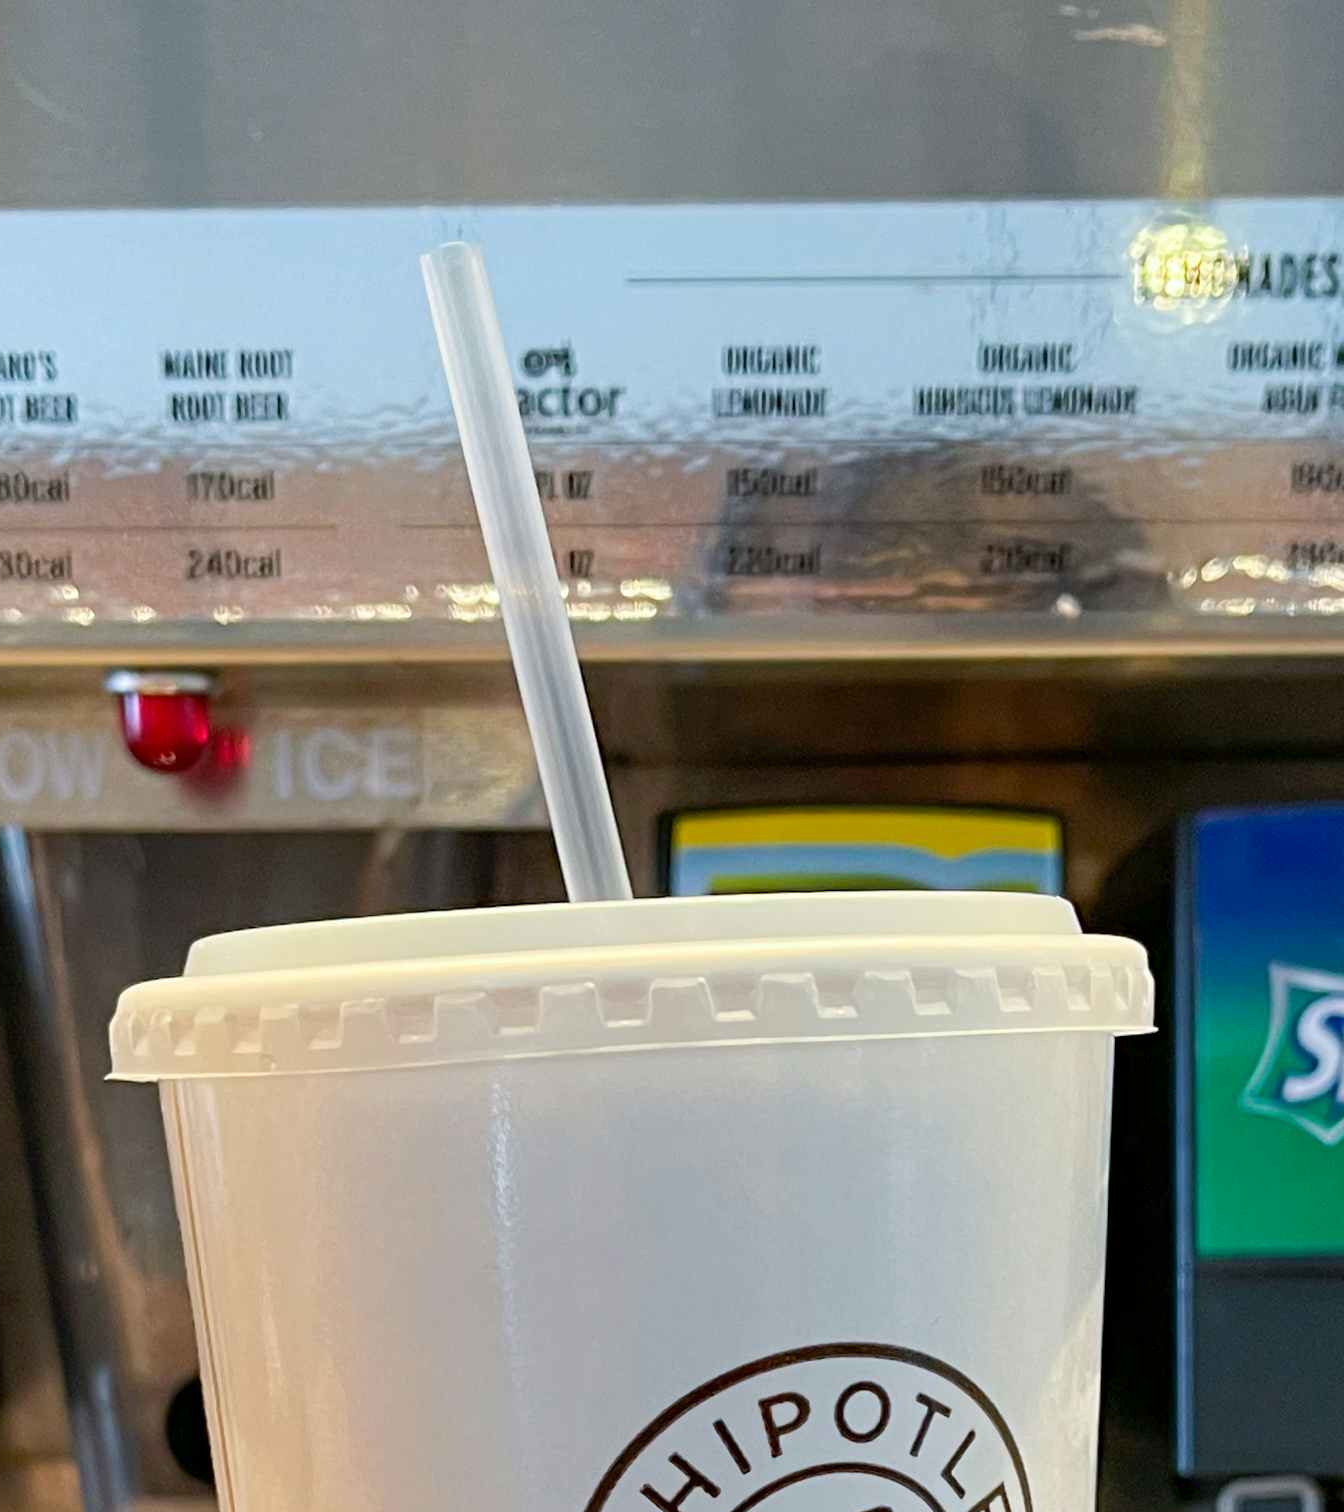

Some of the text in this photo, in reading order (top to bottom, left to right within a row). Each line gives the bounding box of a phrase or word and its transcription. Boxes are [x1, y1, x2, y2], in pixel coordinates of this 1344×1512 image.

[240, 349, 294, 379] ROOT
[722, 345, 822, 375] ORGANIC
[977, 342, 1076, 373] ORGANIC
[24, 392, 78, 423] BEER
[171, 391, 289, 422] ROOT BEER
[517, 386, 626, 417] actor
[187, 471, 276, 502] 170cal
[276, 724, 419, 800] ICE
